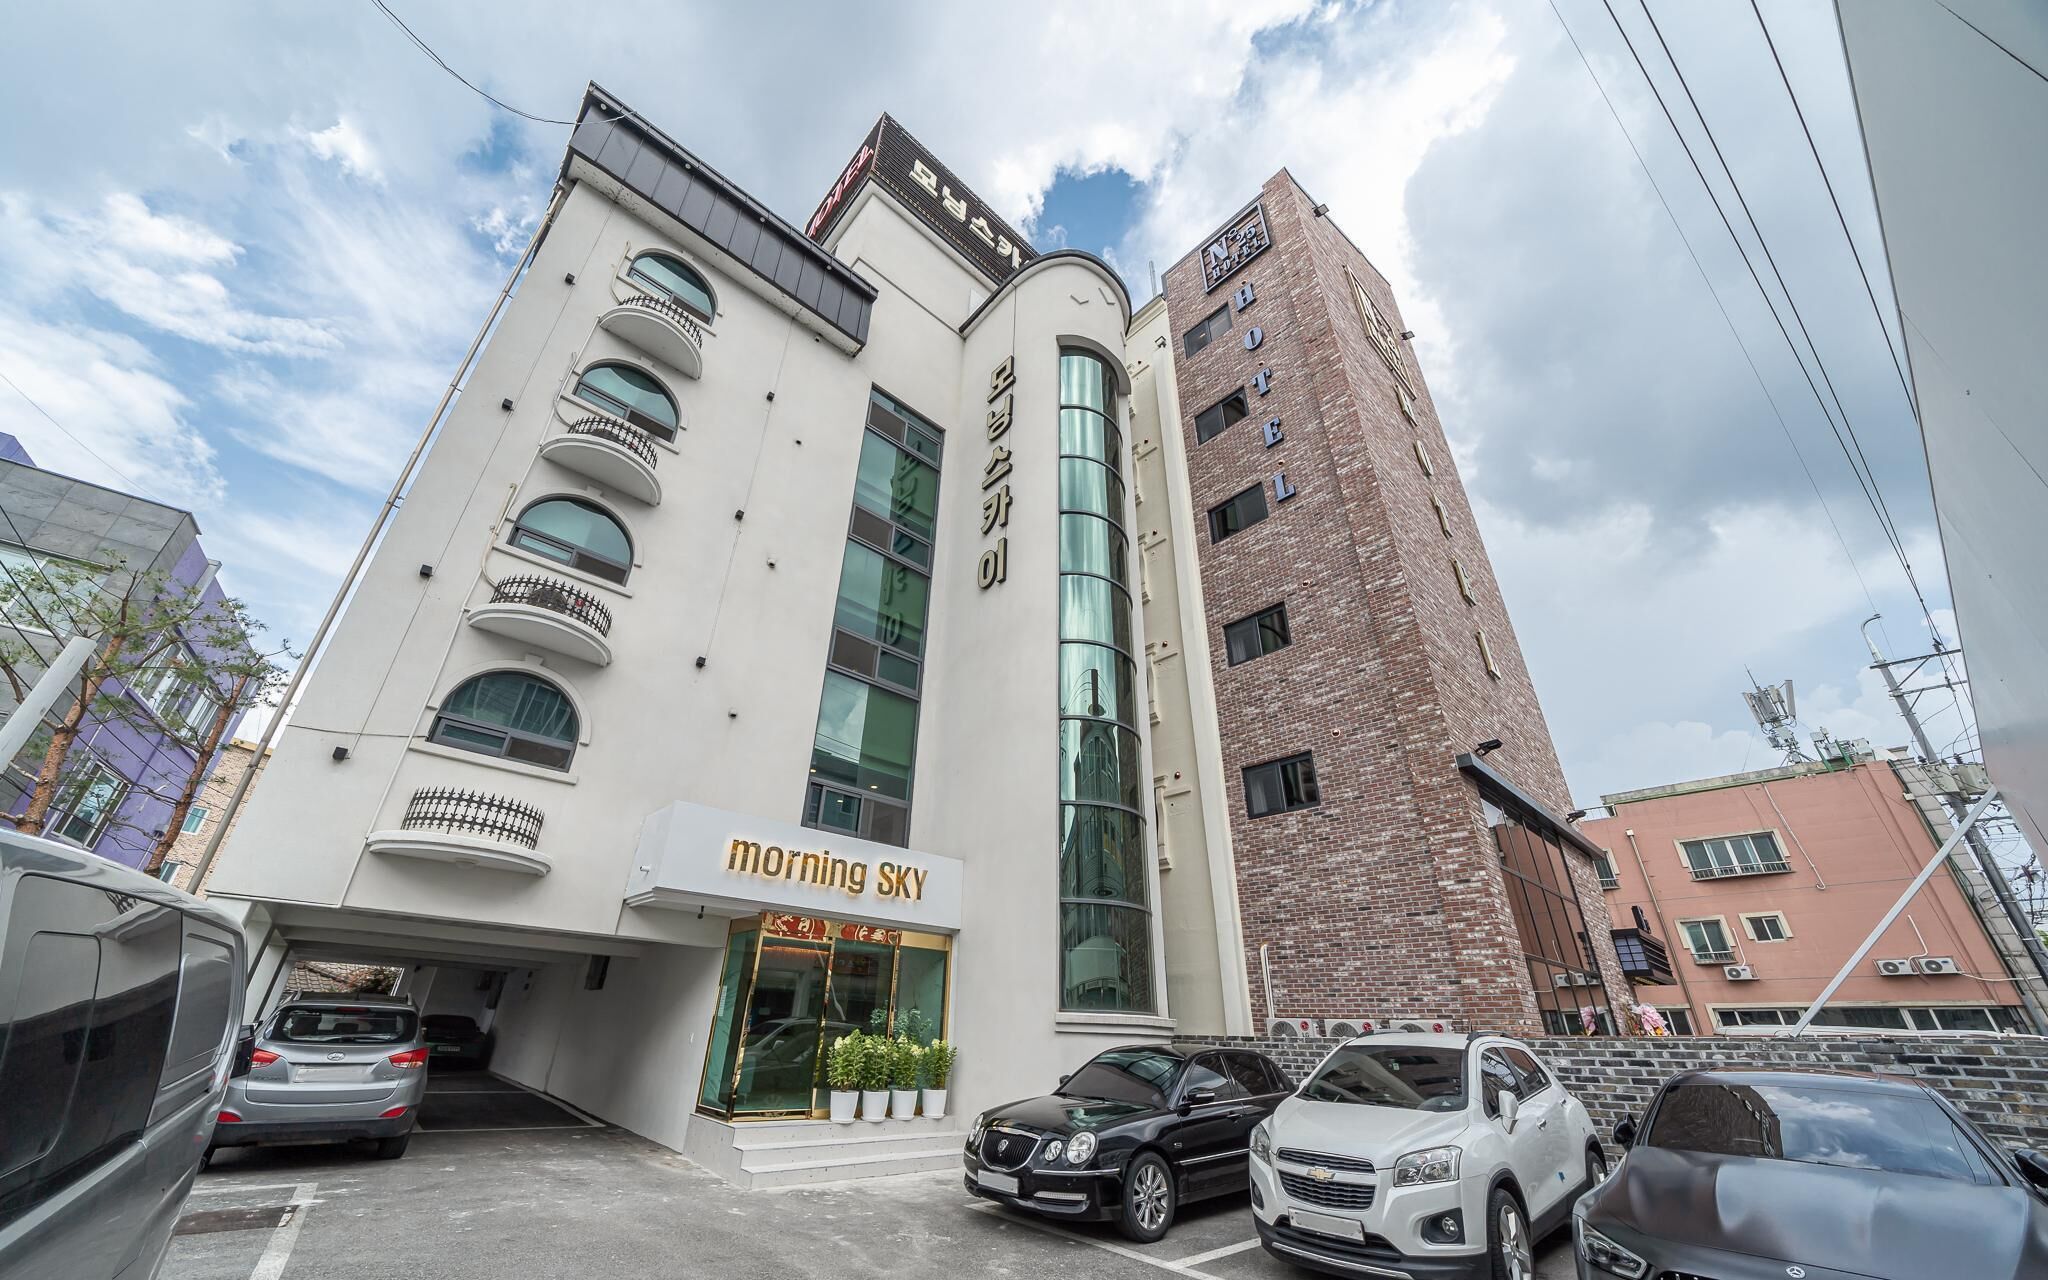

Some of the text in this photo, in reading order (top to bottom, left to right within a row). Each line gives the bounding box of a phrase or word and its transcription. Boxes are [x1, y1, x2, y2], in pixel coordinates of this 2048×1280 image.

[909, 158, 1030, 271] 모닝스카
[1211, 236, 1261, 280] HOTEL
[1233, 281, 1297, 503] HOTEL
[978, 354, 1016, 589] 모닝스카이
[727, 837, 929, 901] morning SKY
